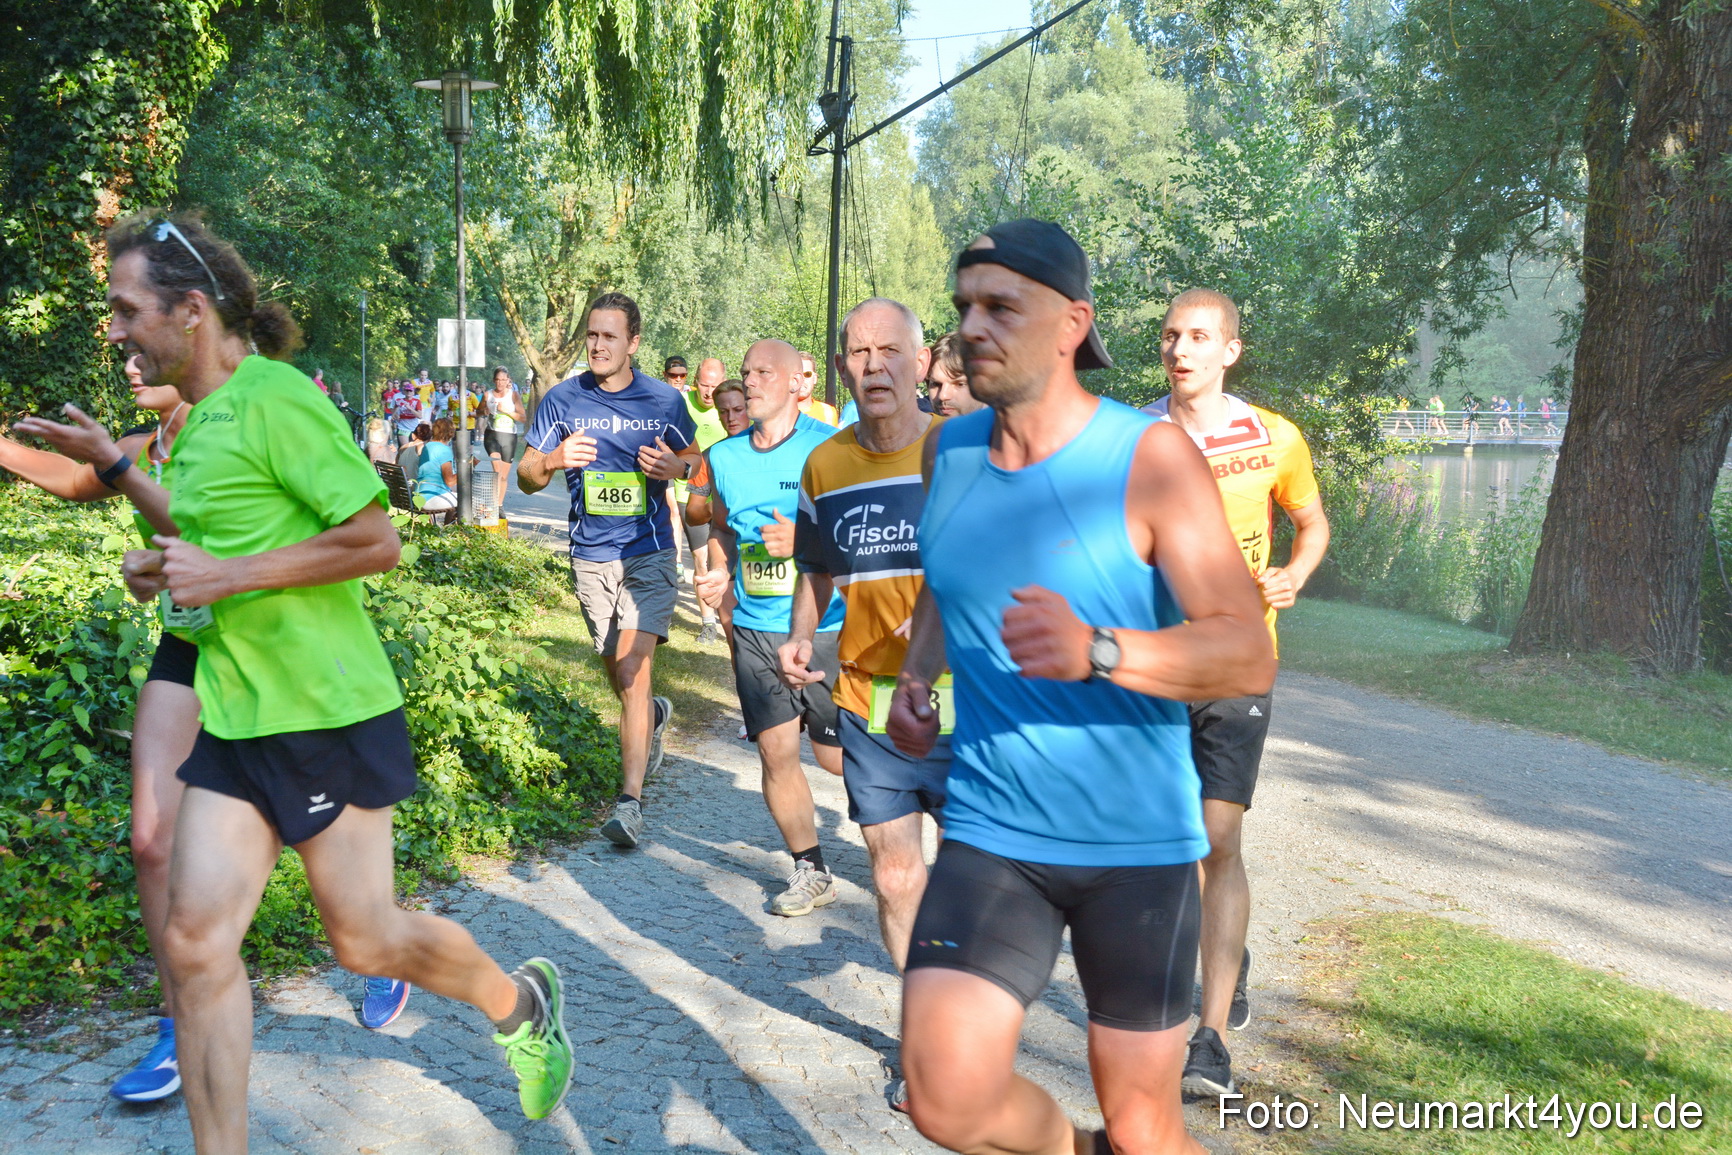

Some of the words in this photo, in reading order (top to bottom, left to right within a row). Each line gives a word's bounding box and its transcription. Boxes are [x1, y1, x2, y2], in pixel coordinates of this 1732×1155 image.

[574, 418, 610, 430] EURO
[623, 419, 661, 431] POLES
[1212, 454, 1275, 479] BÖGL
[779, 481, 799, 490] THU
[597, 487, 632, 503] 486
[848, 519, 920, 545] Fisch
[855, 542, 921, 557] AUTOMOB
[746, 561, 787, 580] 1940
